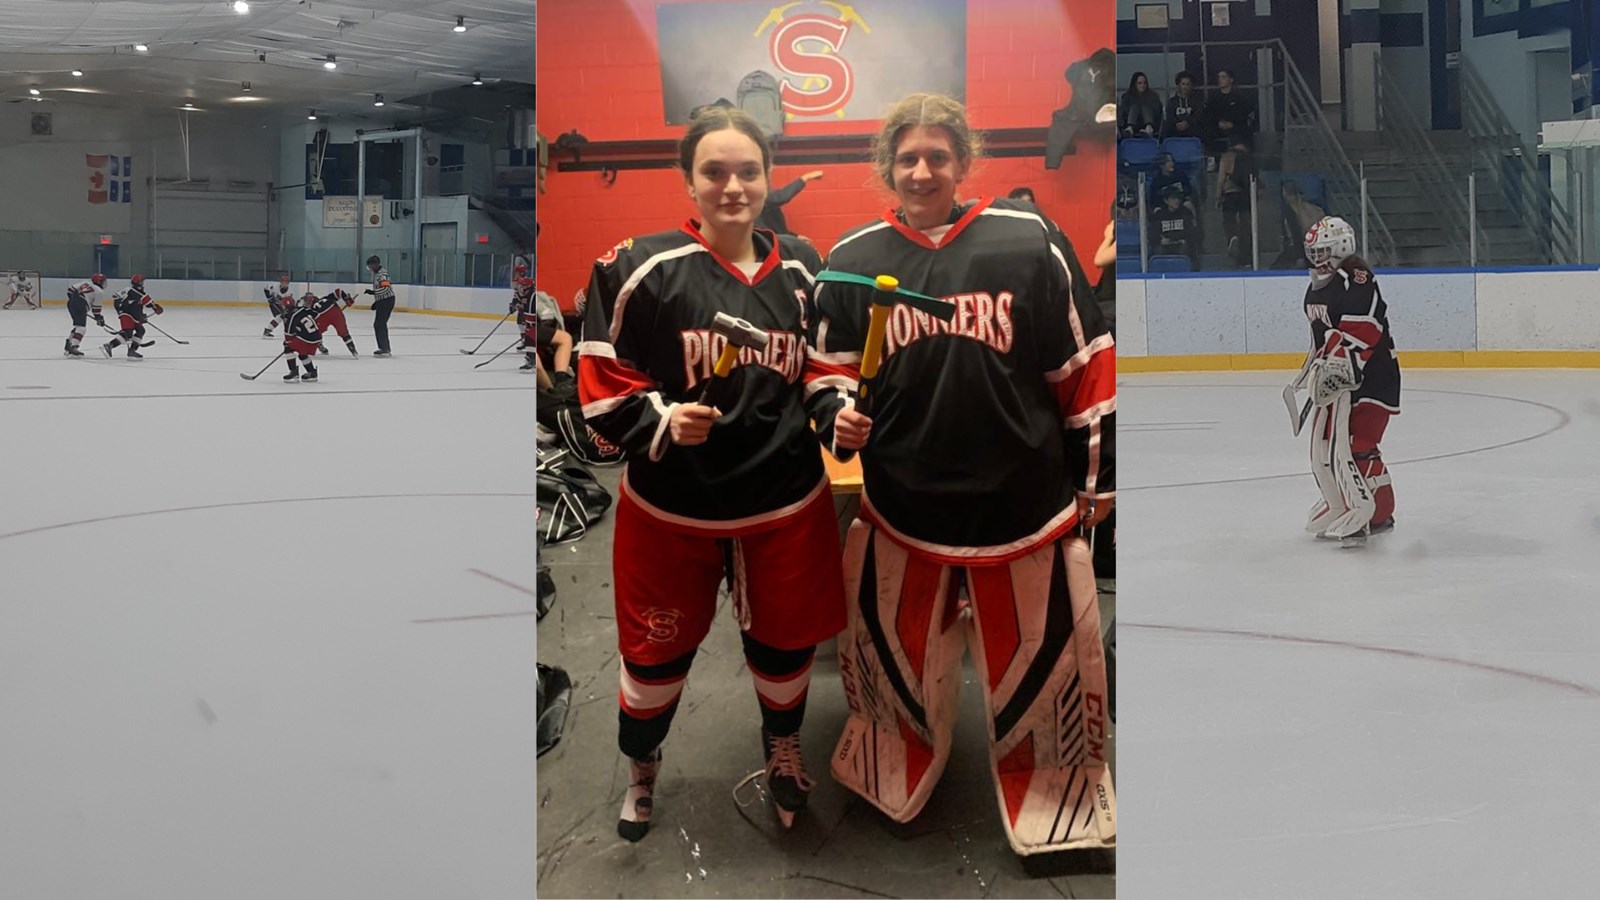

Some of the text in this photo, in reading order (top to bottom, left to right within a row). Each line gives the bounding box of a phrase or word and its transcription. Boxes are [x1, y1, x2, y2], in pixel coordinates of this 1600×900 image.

[769, 13, 855, 117] S
[868, 290, 1014, 365] IONNIERS
[1347, 460, 1369, 500] CCM
[647, 611, 678, 642] S
[1086, 692, 1104, 762] CCM
